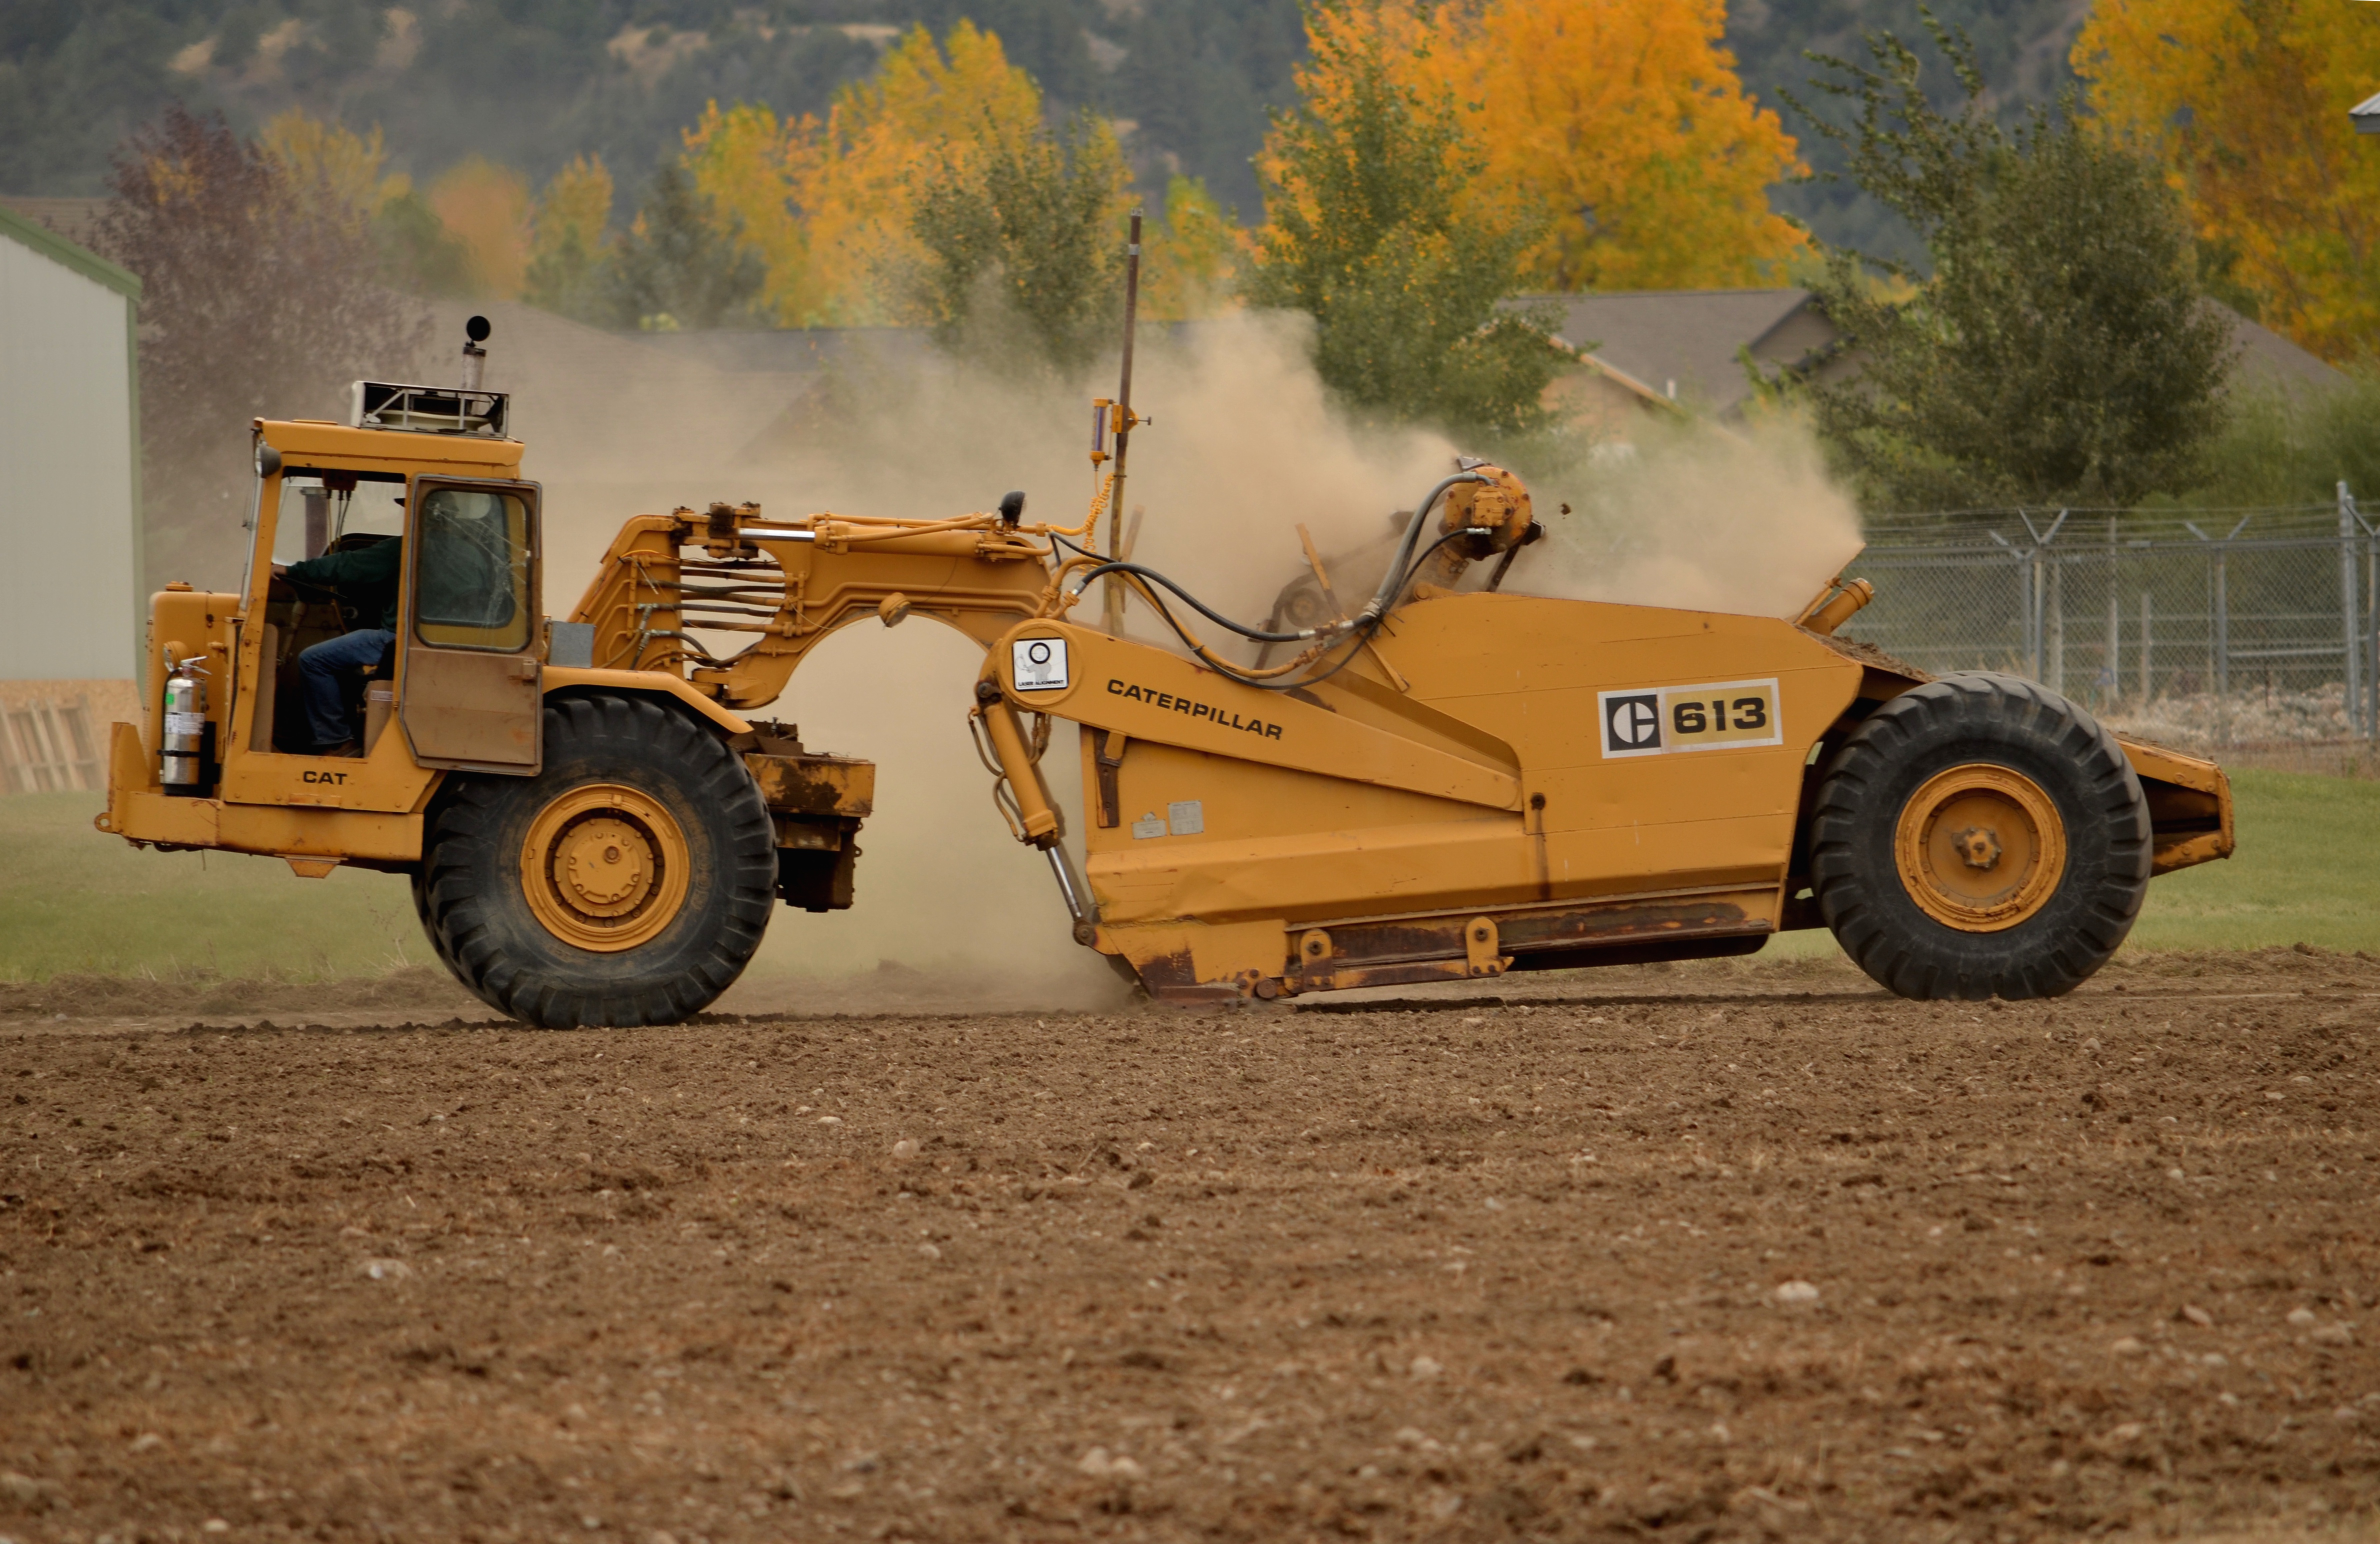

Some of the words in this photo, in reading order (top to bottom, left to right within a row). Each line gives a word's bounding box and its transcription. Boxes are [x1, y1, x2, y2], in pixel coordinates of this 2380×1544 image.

[1106, 679, 1282, 740] CATERPILLAR
[1674, 697, 1766, 734] 613
[303, 770, 348, 785] CAT
